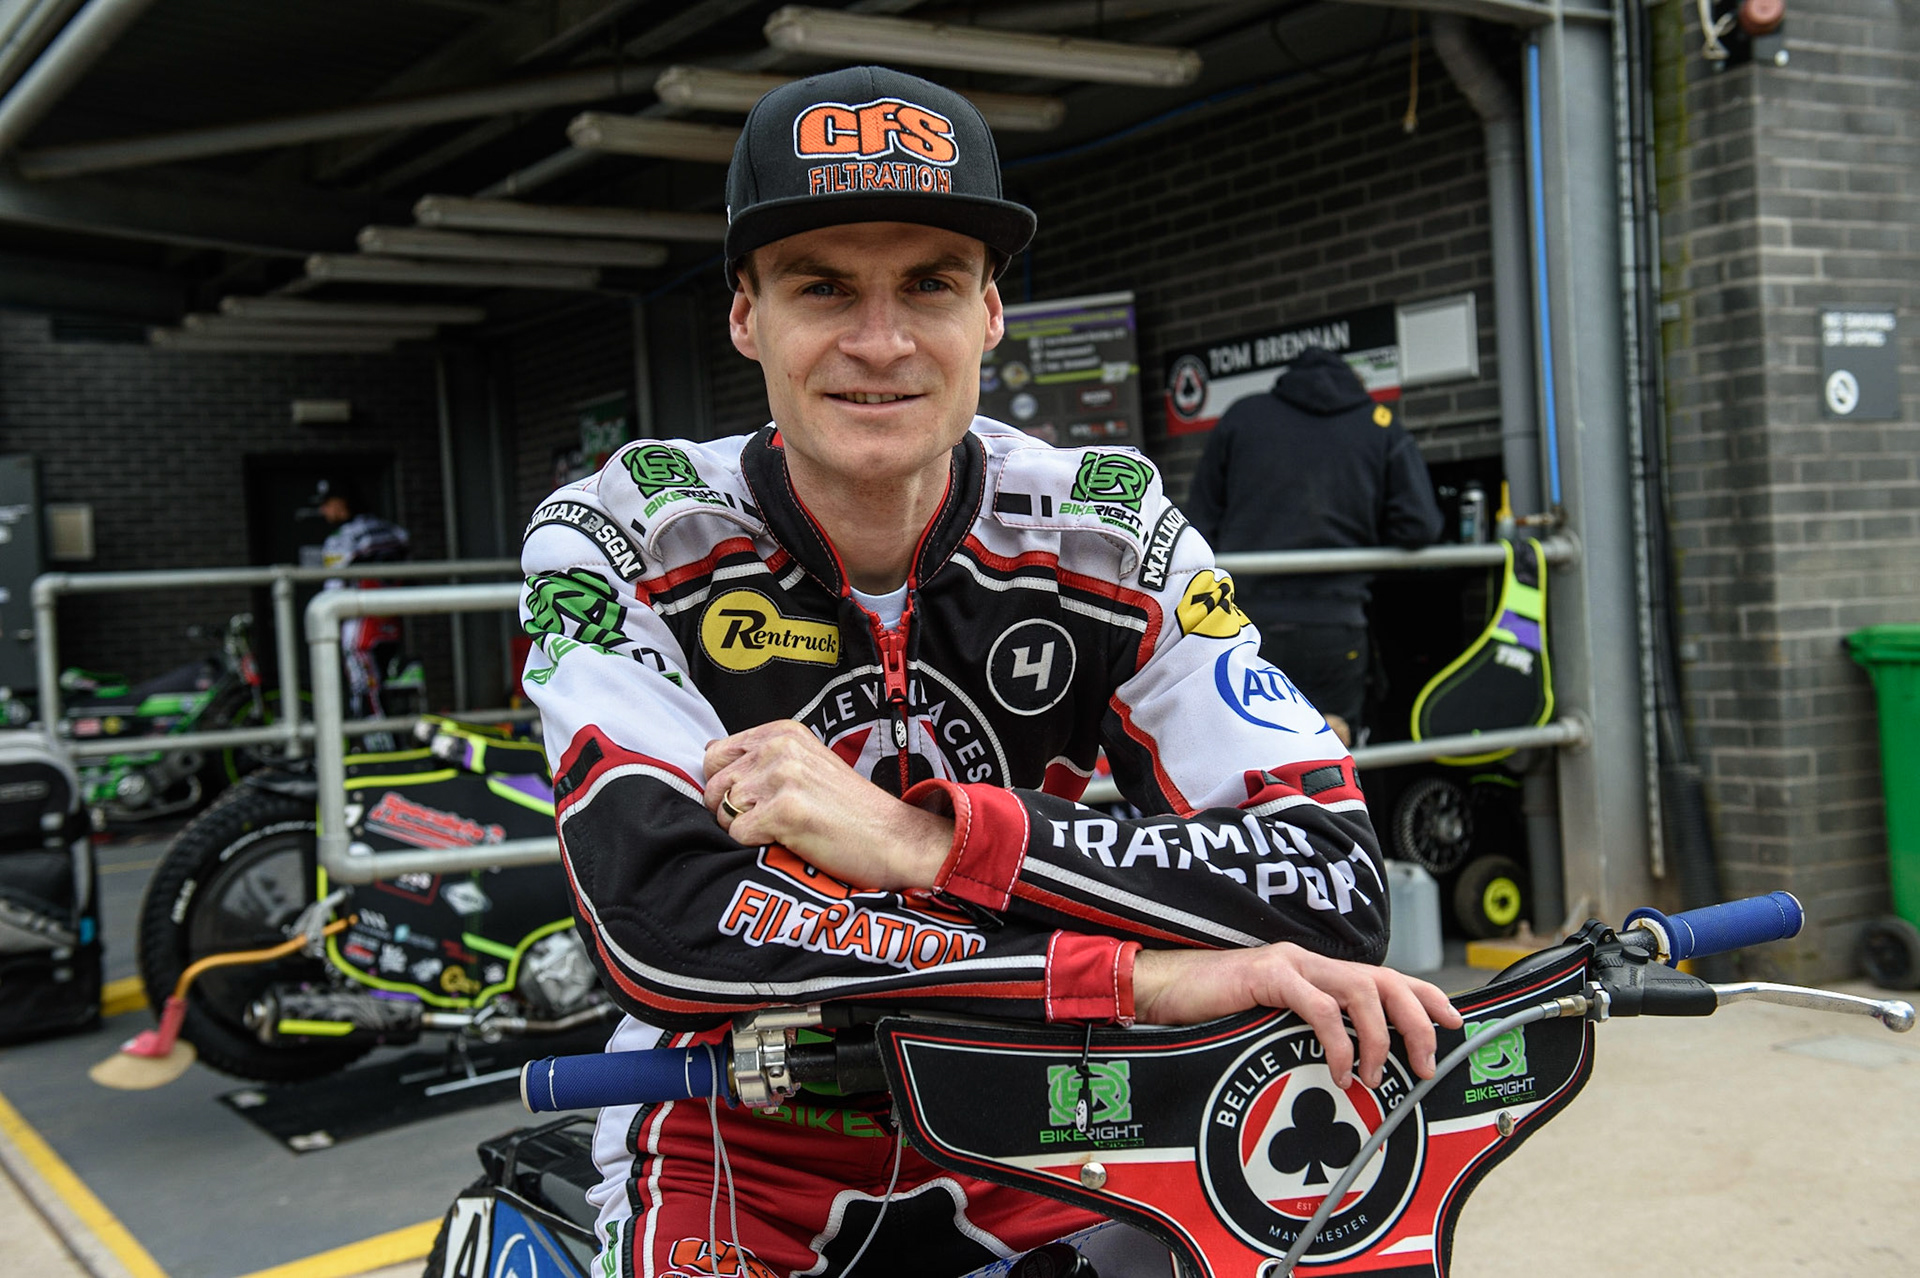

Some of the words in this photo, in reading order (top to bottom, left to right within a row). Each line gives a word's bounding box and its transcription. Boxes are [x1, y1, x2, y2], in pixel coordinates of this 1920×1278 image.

[795, 99, 958, 165] CFS
[809, 162, 951, 195] FILTRATION
[1208, 341, 1252, 375] TOM
[1059, 502, 1143, 530] BIKERIGHT
[718, 608, 837, 653] Rentruck
[1012, 641, 1056, 692] 4
[928, 700, 993, 783] ACES
[1215, 1051, 1281, 1129] BELLE
[1289, 1039, 1325, 1061] VU
[1465, 1077, 1535, 1103] BIKERIGHT
[1040, 1124, 1143, 1143] BIKERIGHT
[1269, 1214, 1369, 1244] MANHESTER
